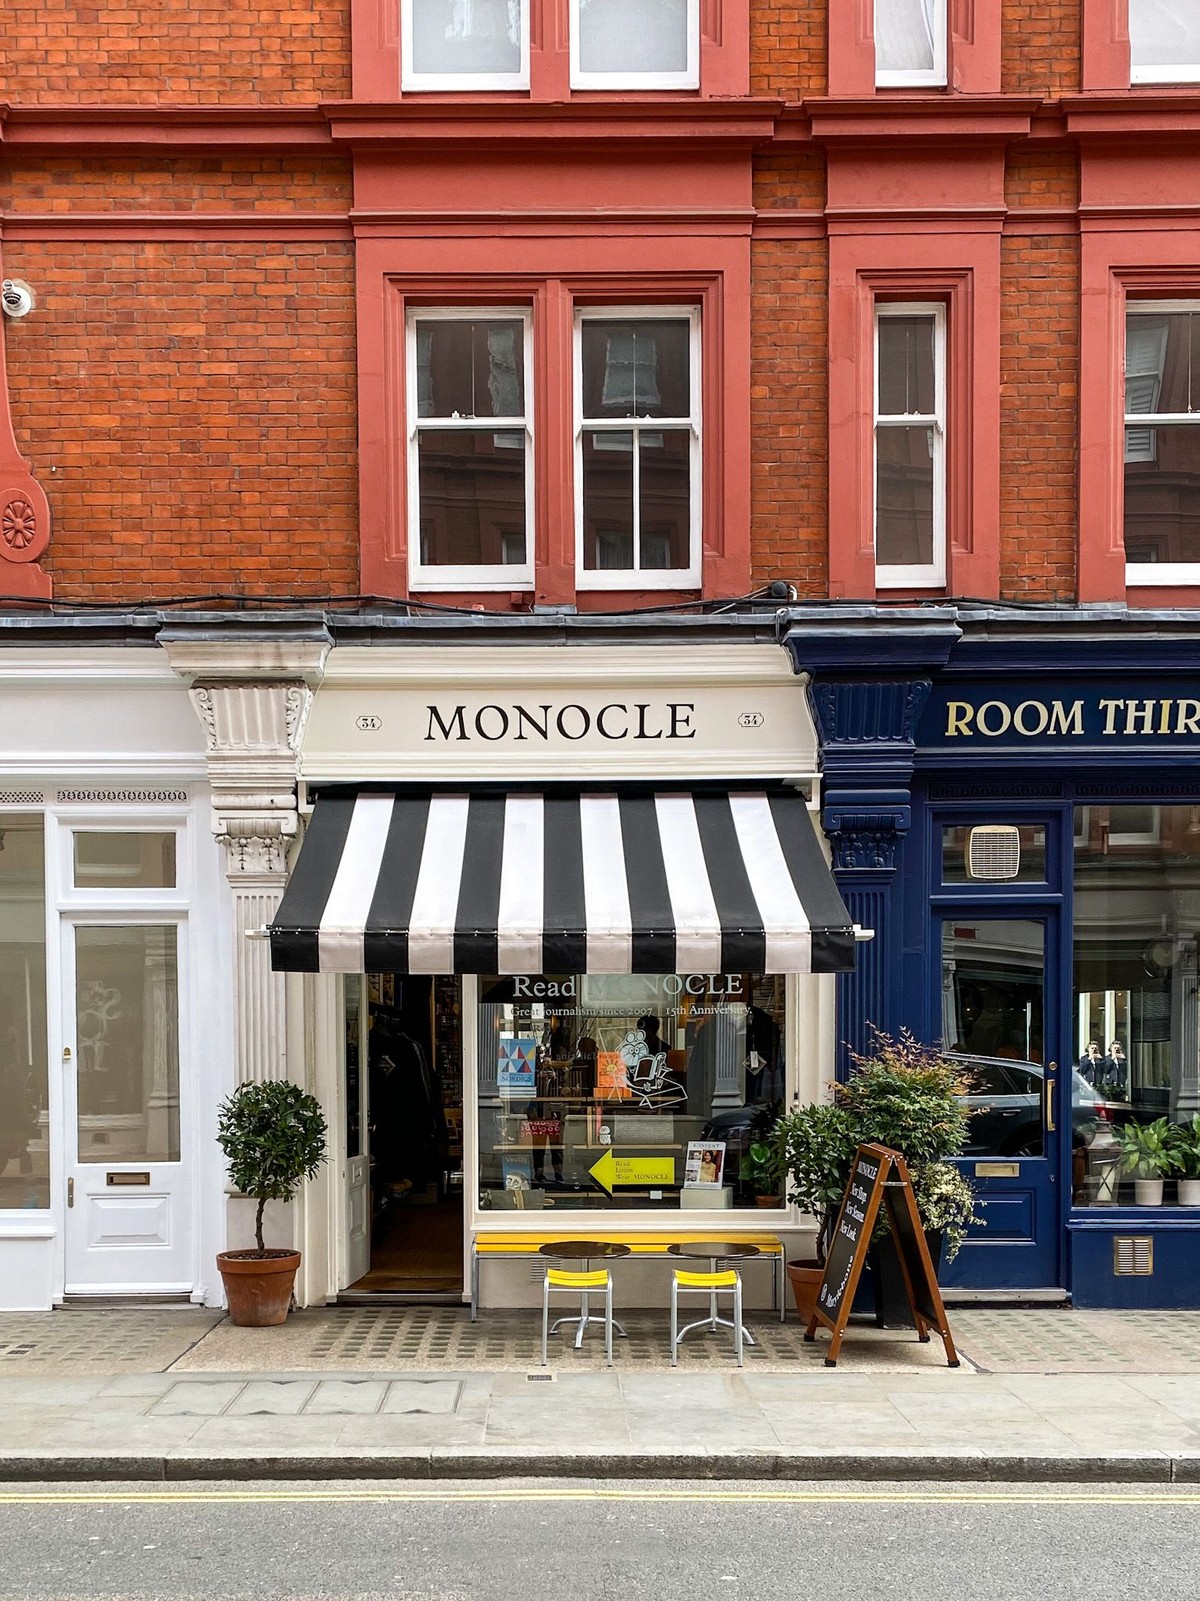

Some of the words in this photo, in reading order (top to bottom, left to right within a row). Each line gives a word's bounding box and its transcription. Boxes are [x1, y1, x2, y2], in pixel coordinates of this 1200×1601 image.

[361, 718, 377, 729] 34
[424, 704, 697, 741] MONOCLE
[743, 715, 758, 725] 34
[945, 700, 1085, 737] ROOM
[1099, 699, 1200, 735] THIR
[512, 975, 577, 997] Read
[510, 1006, 539, 1017] Great
[600, 1007, 625, 1016] since
[628, 1007, 653, 1017] 2007
[666, 1006, 687, 1017] 15th
